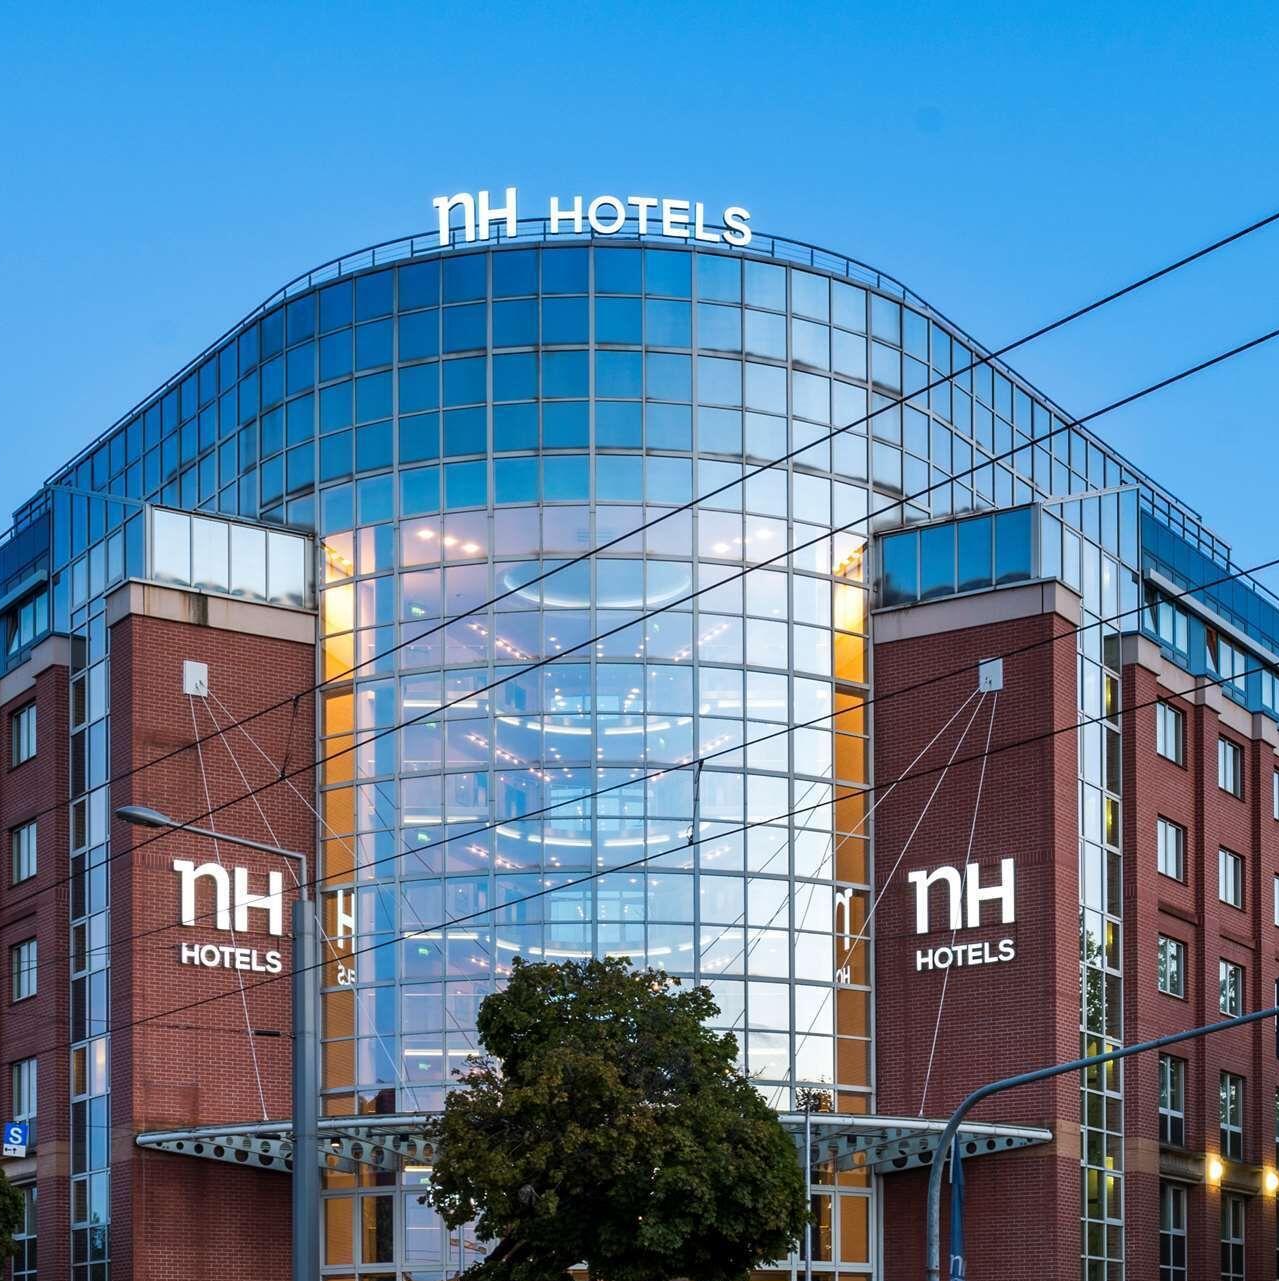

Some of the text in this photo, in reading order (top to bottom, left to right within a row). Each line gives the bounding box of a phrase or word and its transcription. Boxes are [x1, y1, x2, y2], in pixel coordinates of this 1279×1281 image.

[433, 187, 752, 246] nH HOTELS
[174, 859, 283, 936] nH
[908, 857, 1015, 935] nH
[181, 943, 283, 974] HOTELS
[915, 938, 1016, 972] HOTELS
[9, 1127, 22, 1144] S
